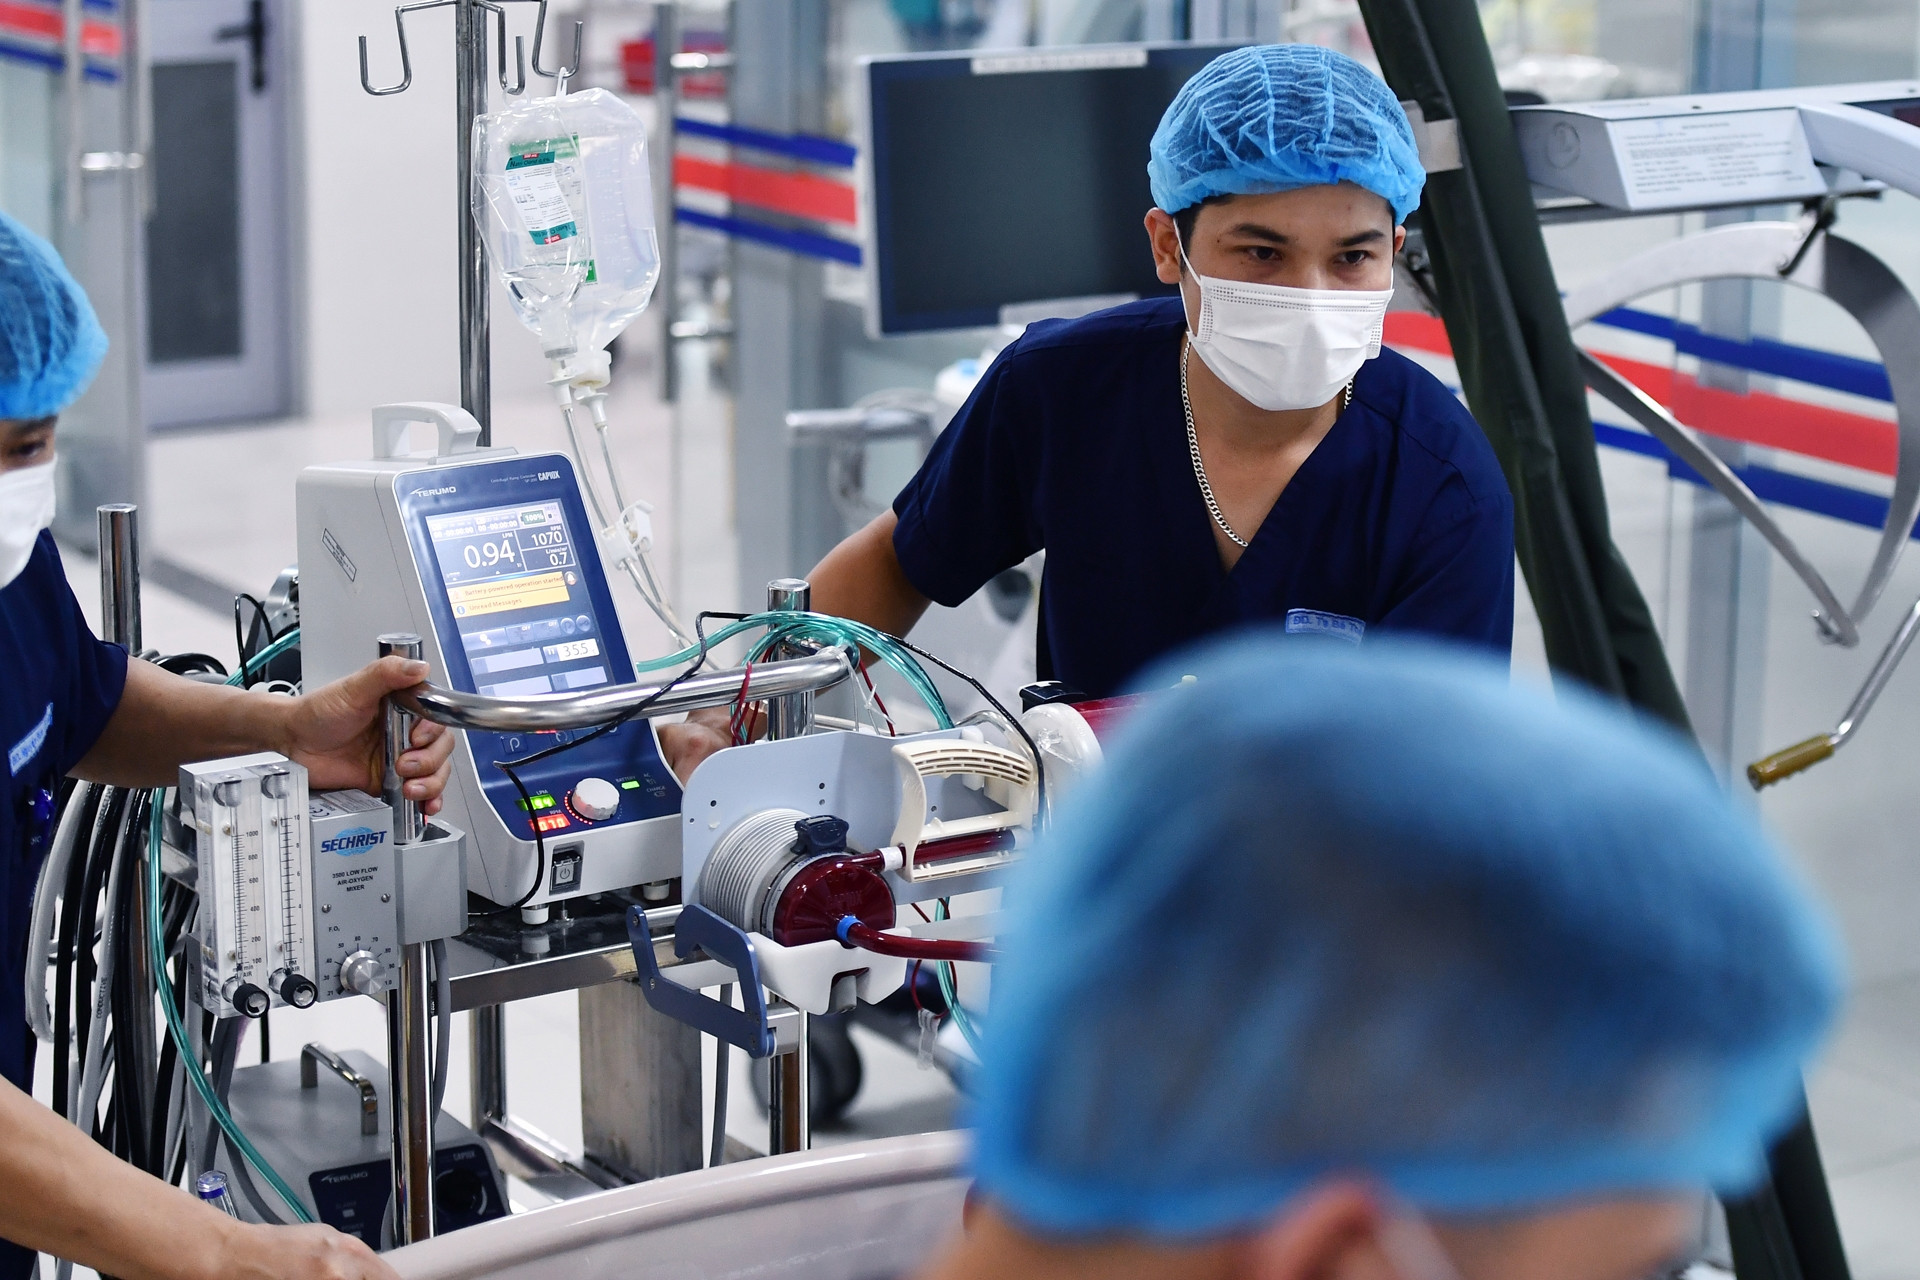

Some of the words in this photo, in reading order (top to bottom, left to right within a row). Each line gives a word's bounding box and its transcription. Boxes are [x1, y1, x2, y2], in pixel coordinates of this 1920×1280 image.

[537, 470, 560, 481] CAPIOX
[417, 486, 457, 498] TERUMO
[525, 511, 545, 521] 100%
[531, 531, 563, 546] 1070
[463, 539, 516, 569] 0.94
[549, 552, 567, 566] 0.7
[465, 588, 487, 596] Battery
[488, 584, 514, 593] powered
[514, 580, 542, 590] operation
[543, 576, 564, 585] started
[469, 602, 492, 610] Unread
[493, 598, 522, 608] Messages
[615, 775, 636, 783] BATTERY
[321, 831, 387, 853] SECHRIST
[361, 866, 379, 874] FLOW
[337, 875, 374, 885] AIR-OXYGEN
[327, 1171, 368, 1184] TERUMO
